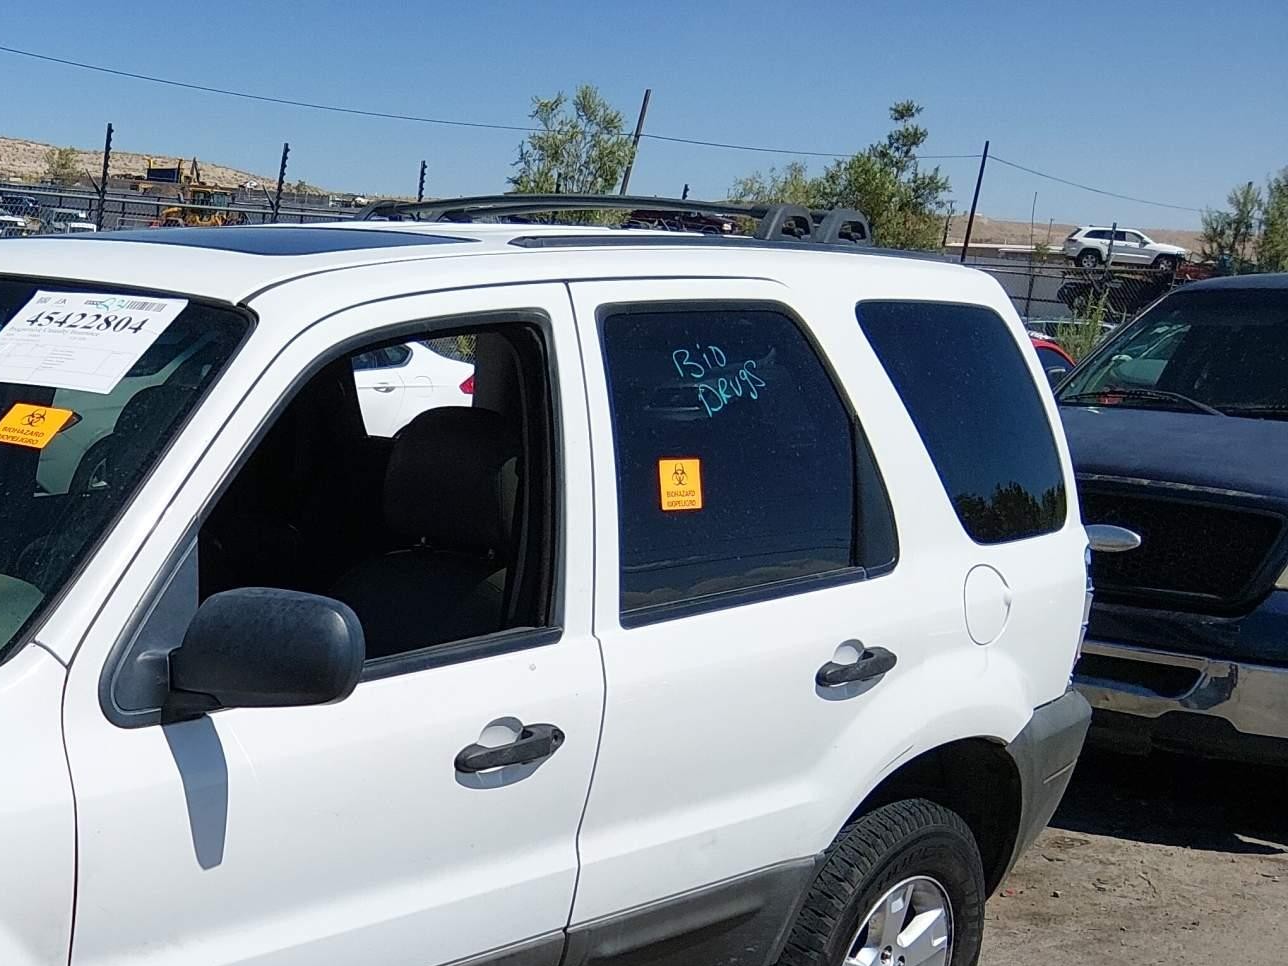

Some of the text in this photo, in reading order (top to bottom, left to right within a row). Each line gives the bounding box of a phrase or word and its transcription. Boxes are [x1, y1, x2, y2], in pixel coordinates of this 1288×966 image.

[27, 311, 149, 333] 45422804
[2, 426, 44, 437] BIOHAZARD
[666, 489, 696, 498] BIOHAZARD
